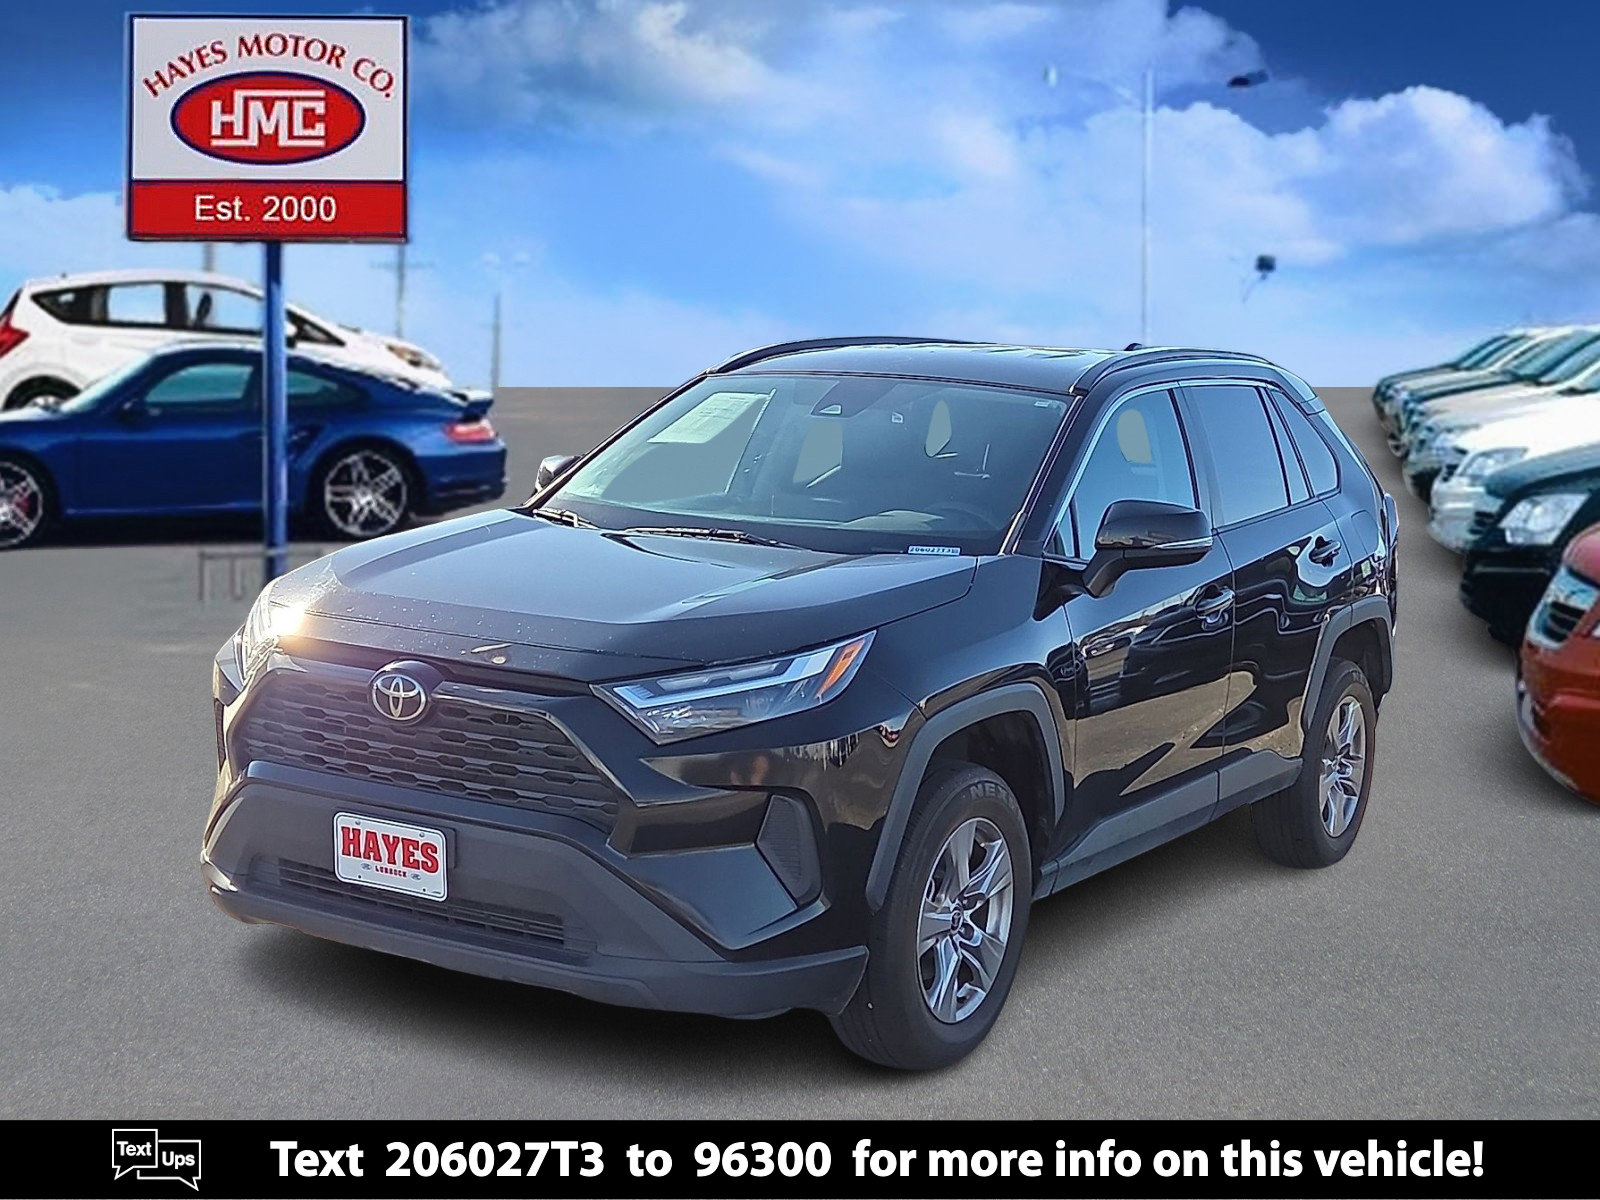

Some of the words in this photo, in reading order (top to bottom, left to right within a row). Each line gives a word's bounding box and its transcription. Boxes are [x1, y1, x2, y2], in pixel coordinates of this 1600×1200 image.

[143, 40, 227, 97] HAYES
[237, 33, 346, 69] MOTOR
[352, 57, 395, 98] CO.
[210, 89, 326, 147] HMC
[194, 194, 250, 222] Est.
[262, 196, 337, 222] 2000
[341, 826, 439, 874] HAYES
